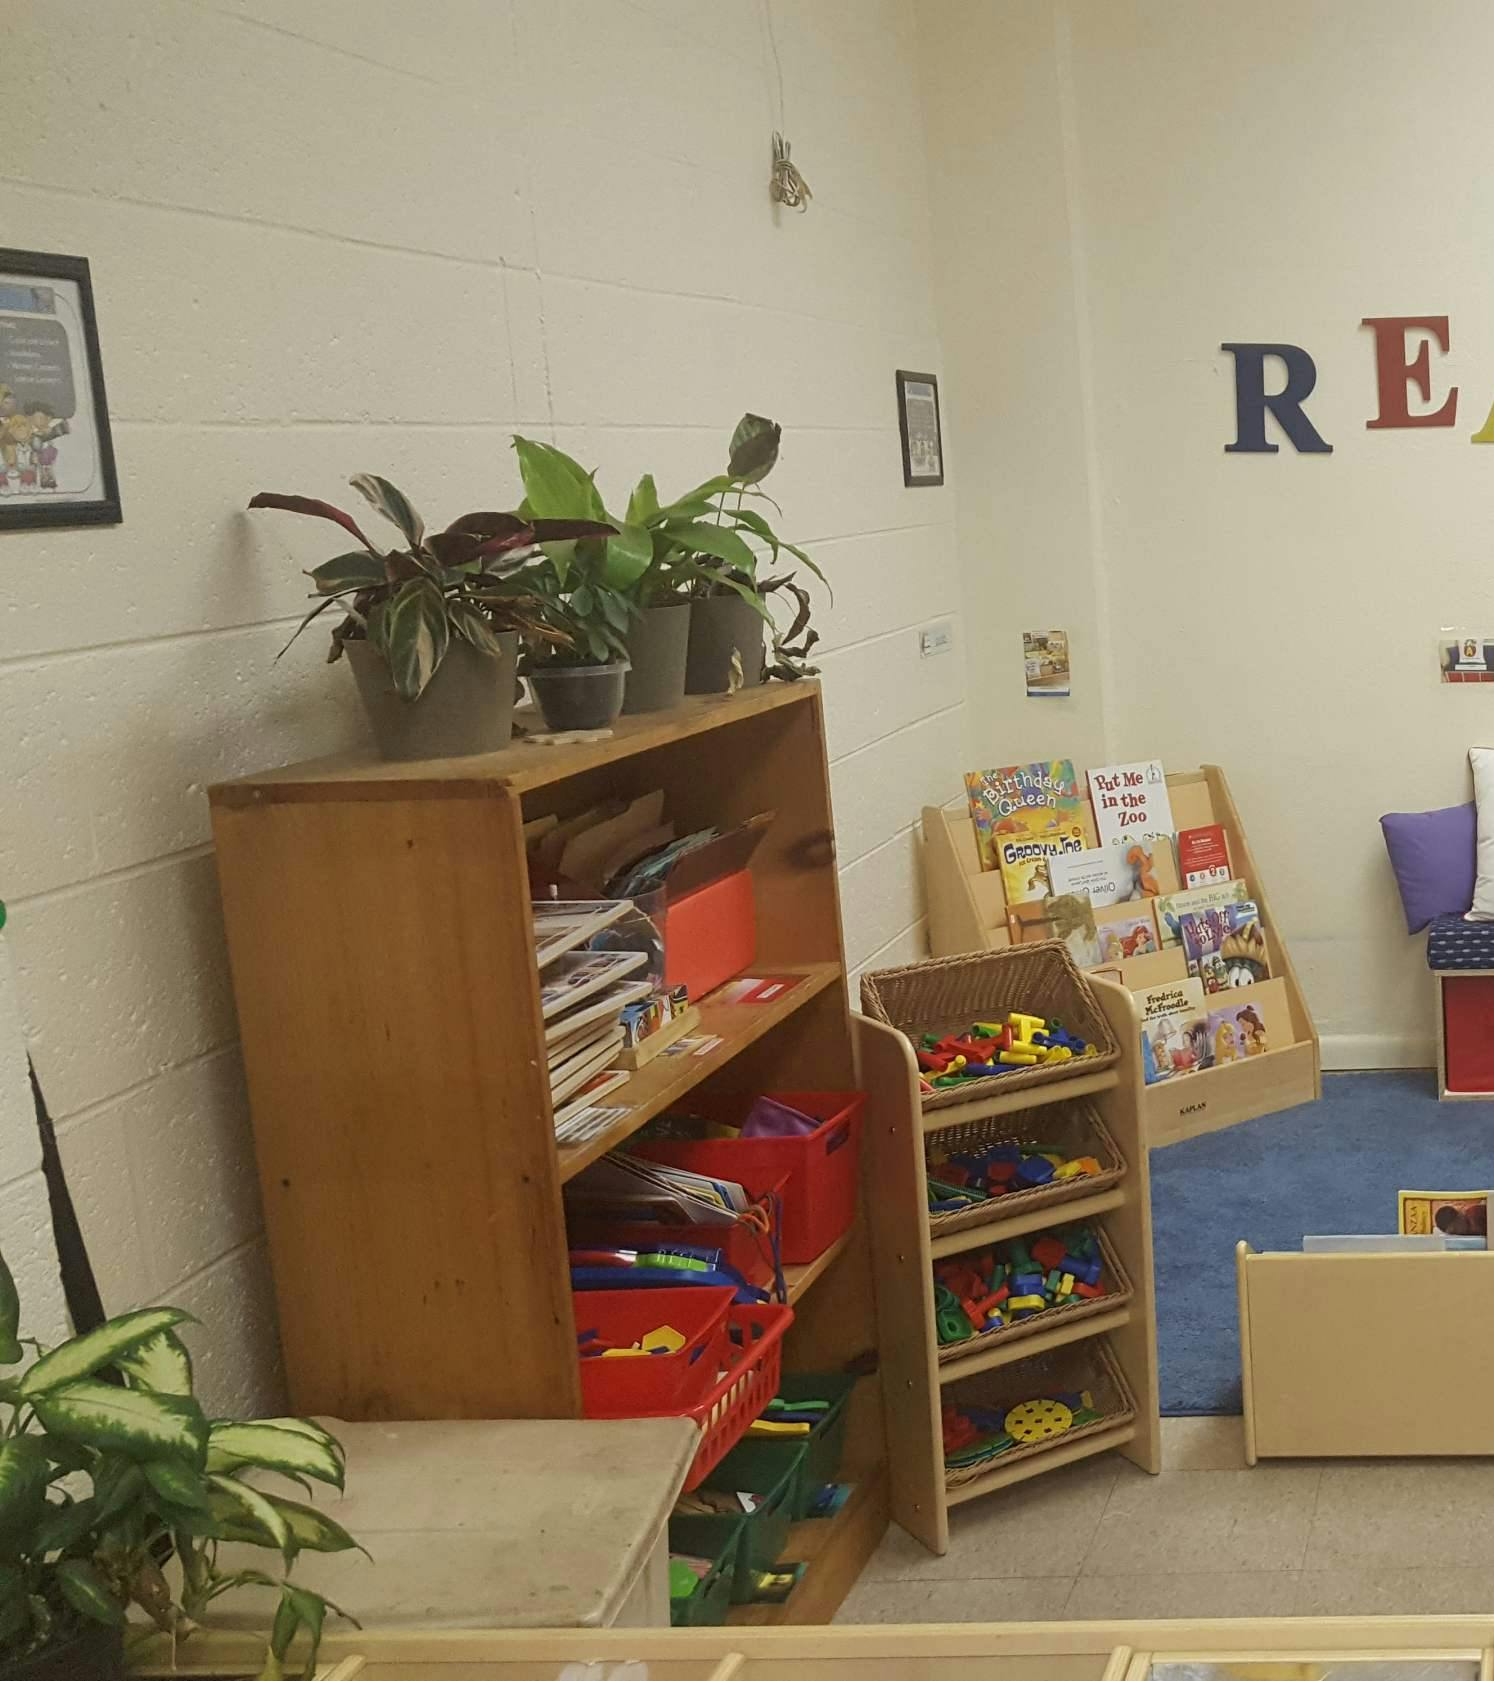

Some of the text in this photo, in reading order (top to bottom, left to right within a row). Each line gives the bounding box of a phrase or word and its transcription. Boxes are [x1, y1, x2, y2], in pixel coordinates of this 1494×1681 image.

[983, 772, 1065, 805] Birthday
[1094, 772, 1143, 791] Put Me
[998, 794, 1056, 816] Queen
[1101, 793, 1146, 808] in the
[1118, 811, 1147, 827] Zoo
